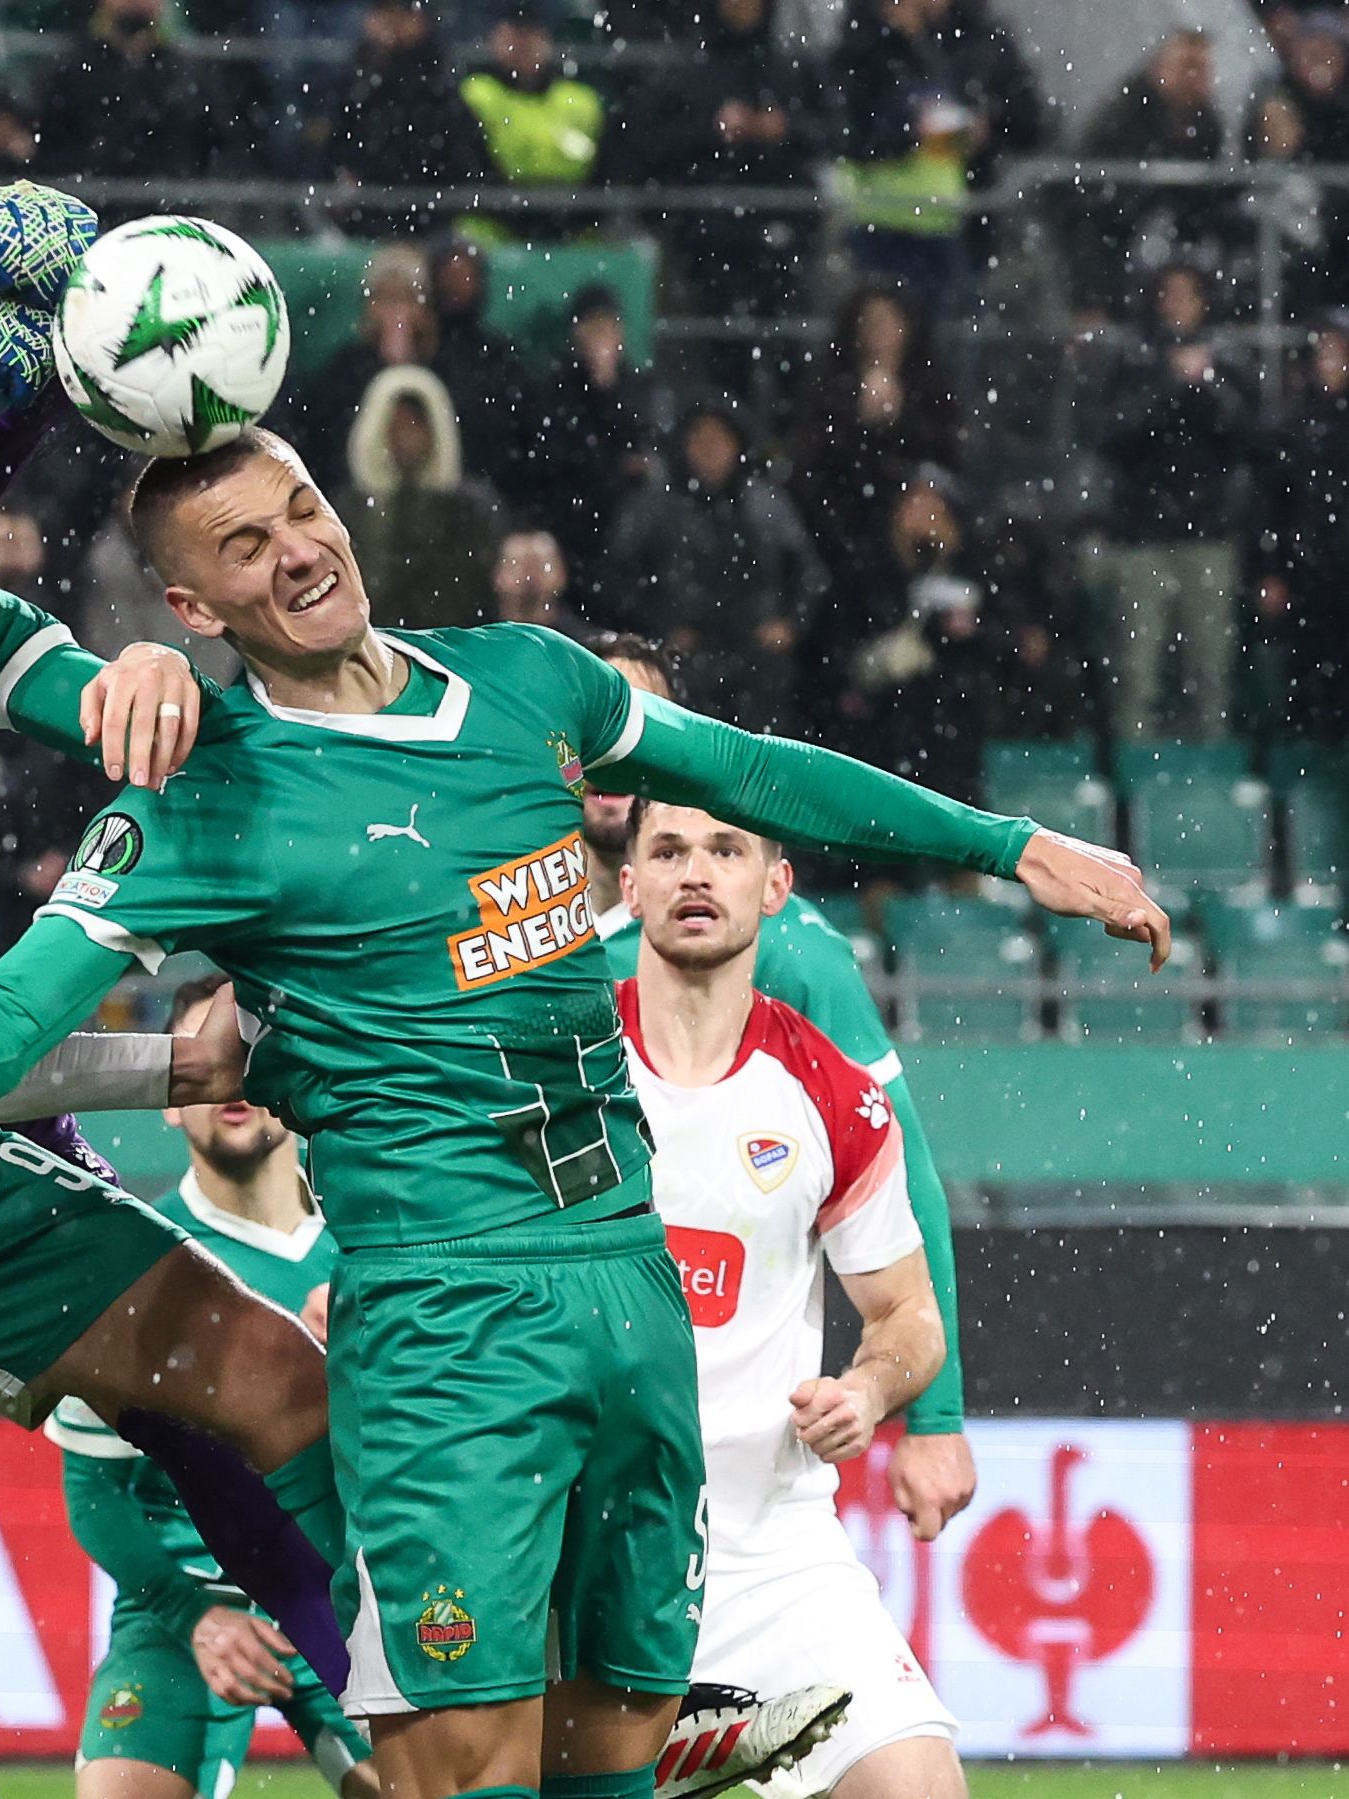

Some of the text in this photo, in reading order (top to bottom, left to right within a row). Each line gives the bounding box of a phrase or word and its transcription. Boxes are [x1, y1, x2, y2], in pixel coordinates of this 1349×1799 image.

[477, 838, 587, 917] WIEN
[457, 882, 594, 982] ENERGI
[677, 1259, 727, 1297] tel
[419, 1622, 472, 1642] RAPID
